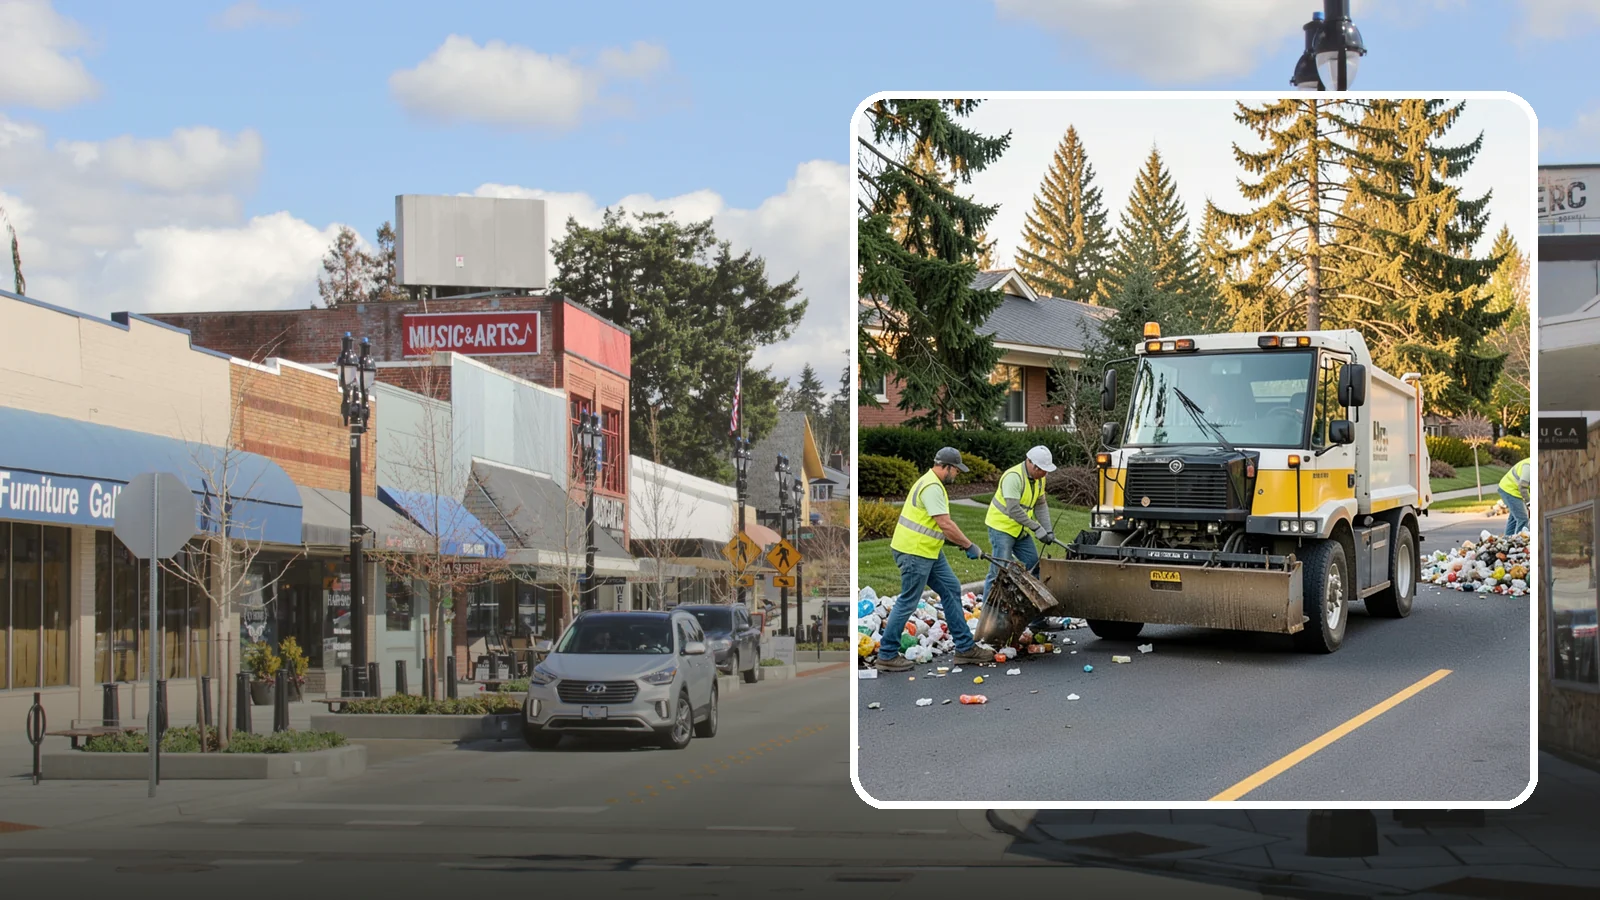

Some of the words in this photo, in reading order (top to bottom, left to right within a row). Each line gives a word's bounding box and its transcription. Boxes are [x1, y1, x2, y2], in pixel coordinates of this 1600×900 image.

[409, 323, 519, 348] MUSIC&ARTS
[0, 471, 79, 515] Furniture
[89, 482, 121, 519] Gal
